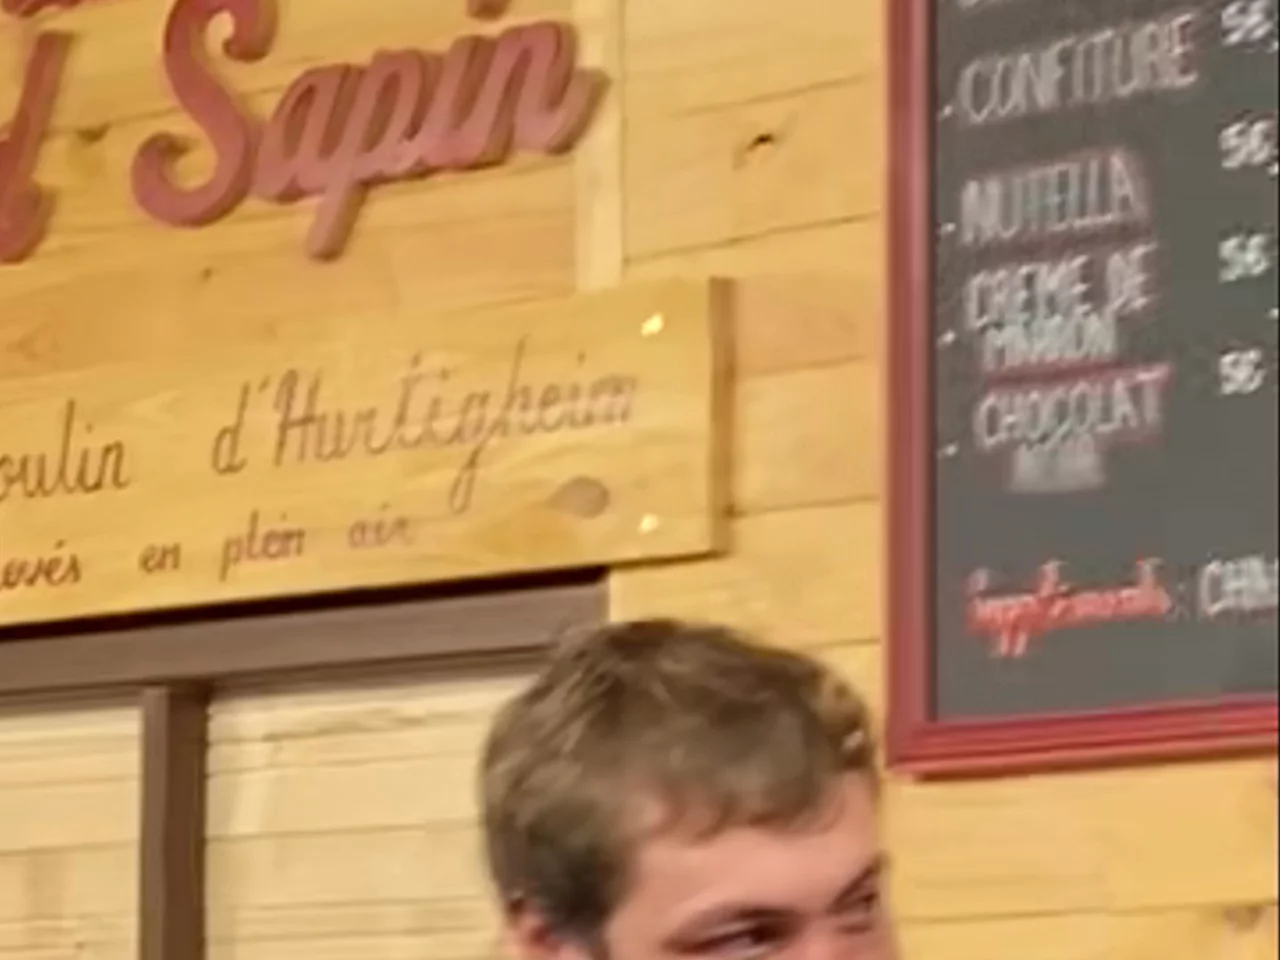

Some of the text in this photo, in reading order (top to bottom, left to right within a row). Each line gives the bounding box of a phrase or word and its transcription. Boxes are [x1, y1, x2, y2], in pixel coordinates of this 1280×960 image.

[130, 0, 608, 262] Sapin
[958, 152, 1146, 246] NUTELLA
[975, 363, 1172, 449] CHOCOLAT
[140, 542, 180, 575] en
